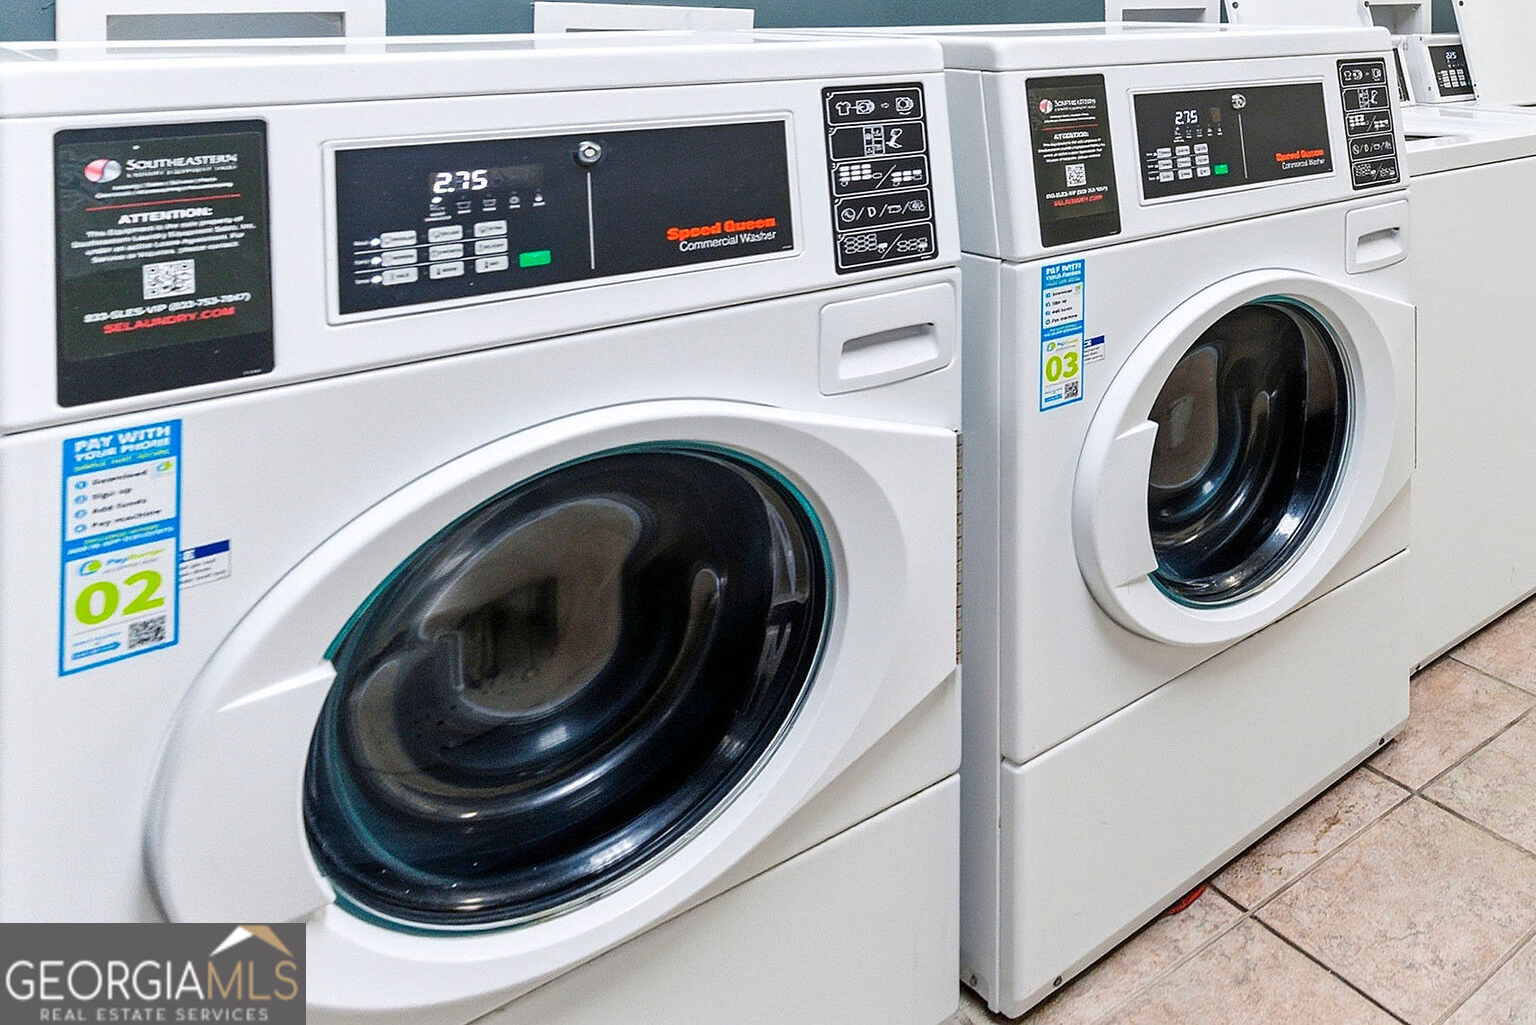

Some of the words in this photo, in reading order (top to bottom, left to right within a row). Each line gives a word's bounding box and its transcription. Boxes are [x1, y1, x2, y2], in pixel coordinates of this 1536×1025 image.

[126, 154, 238, 171] SOUTHEASTERN
[433, 169, 488, 194] 2.75
[118, 206, 213, 224] ATTENTION:
[666, 222, 721, 241] Speed
[724, 218, 776, 233] Queen
[680, 235, 738, 251] Commercial
[740, 231, 777, 243] Washer
[1045, 351, 1079, 383] 03
[74, 435, 113, 453] PAY
[118, 425, 171, 444] WITH
[75, 570, 165, 625] 02
